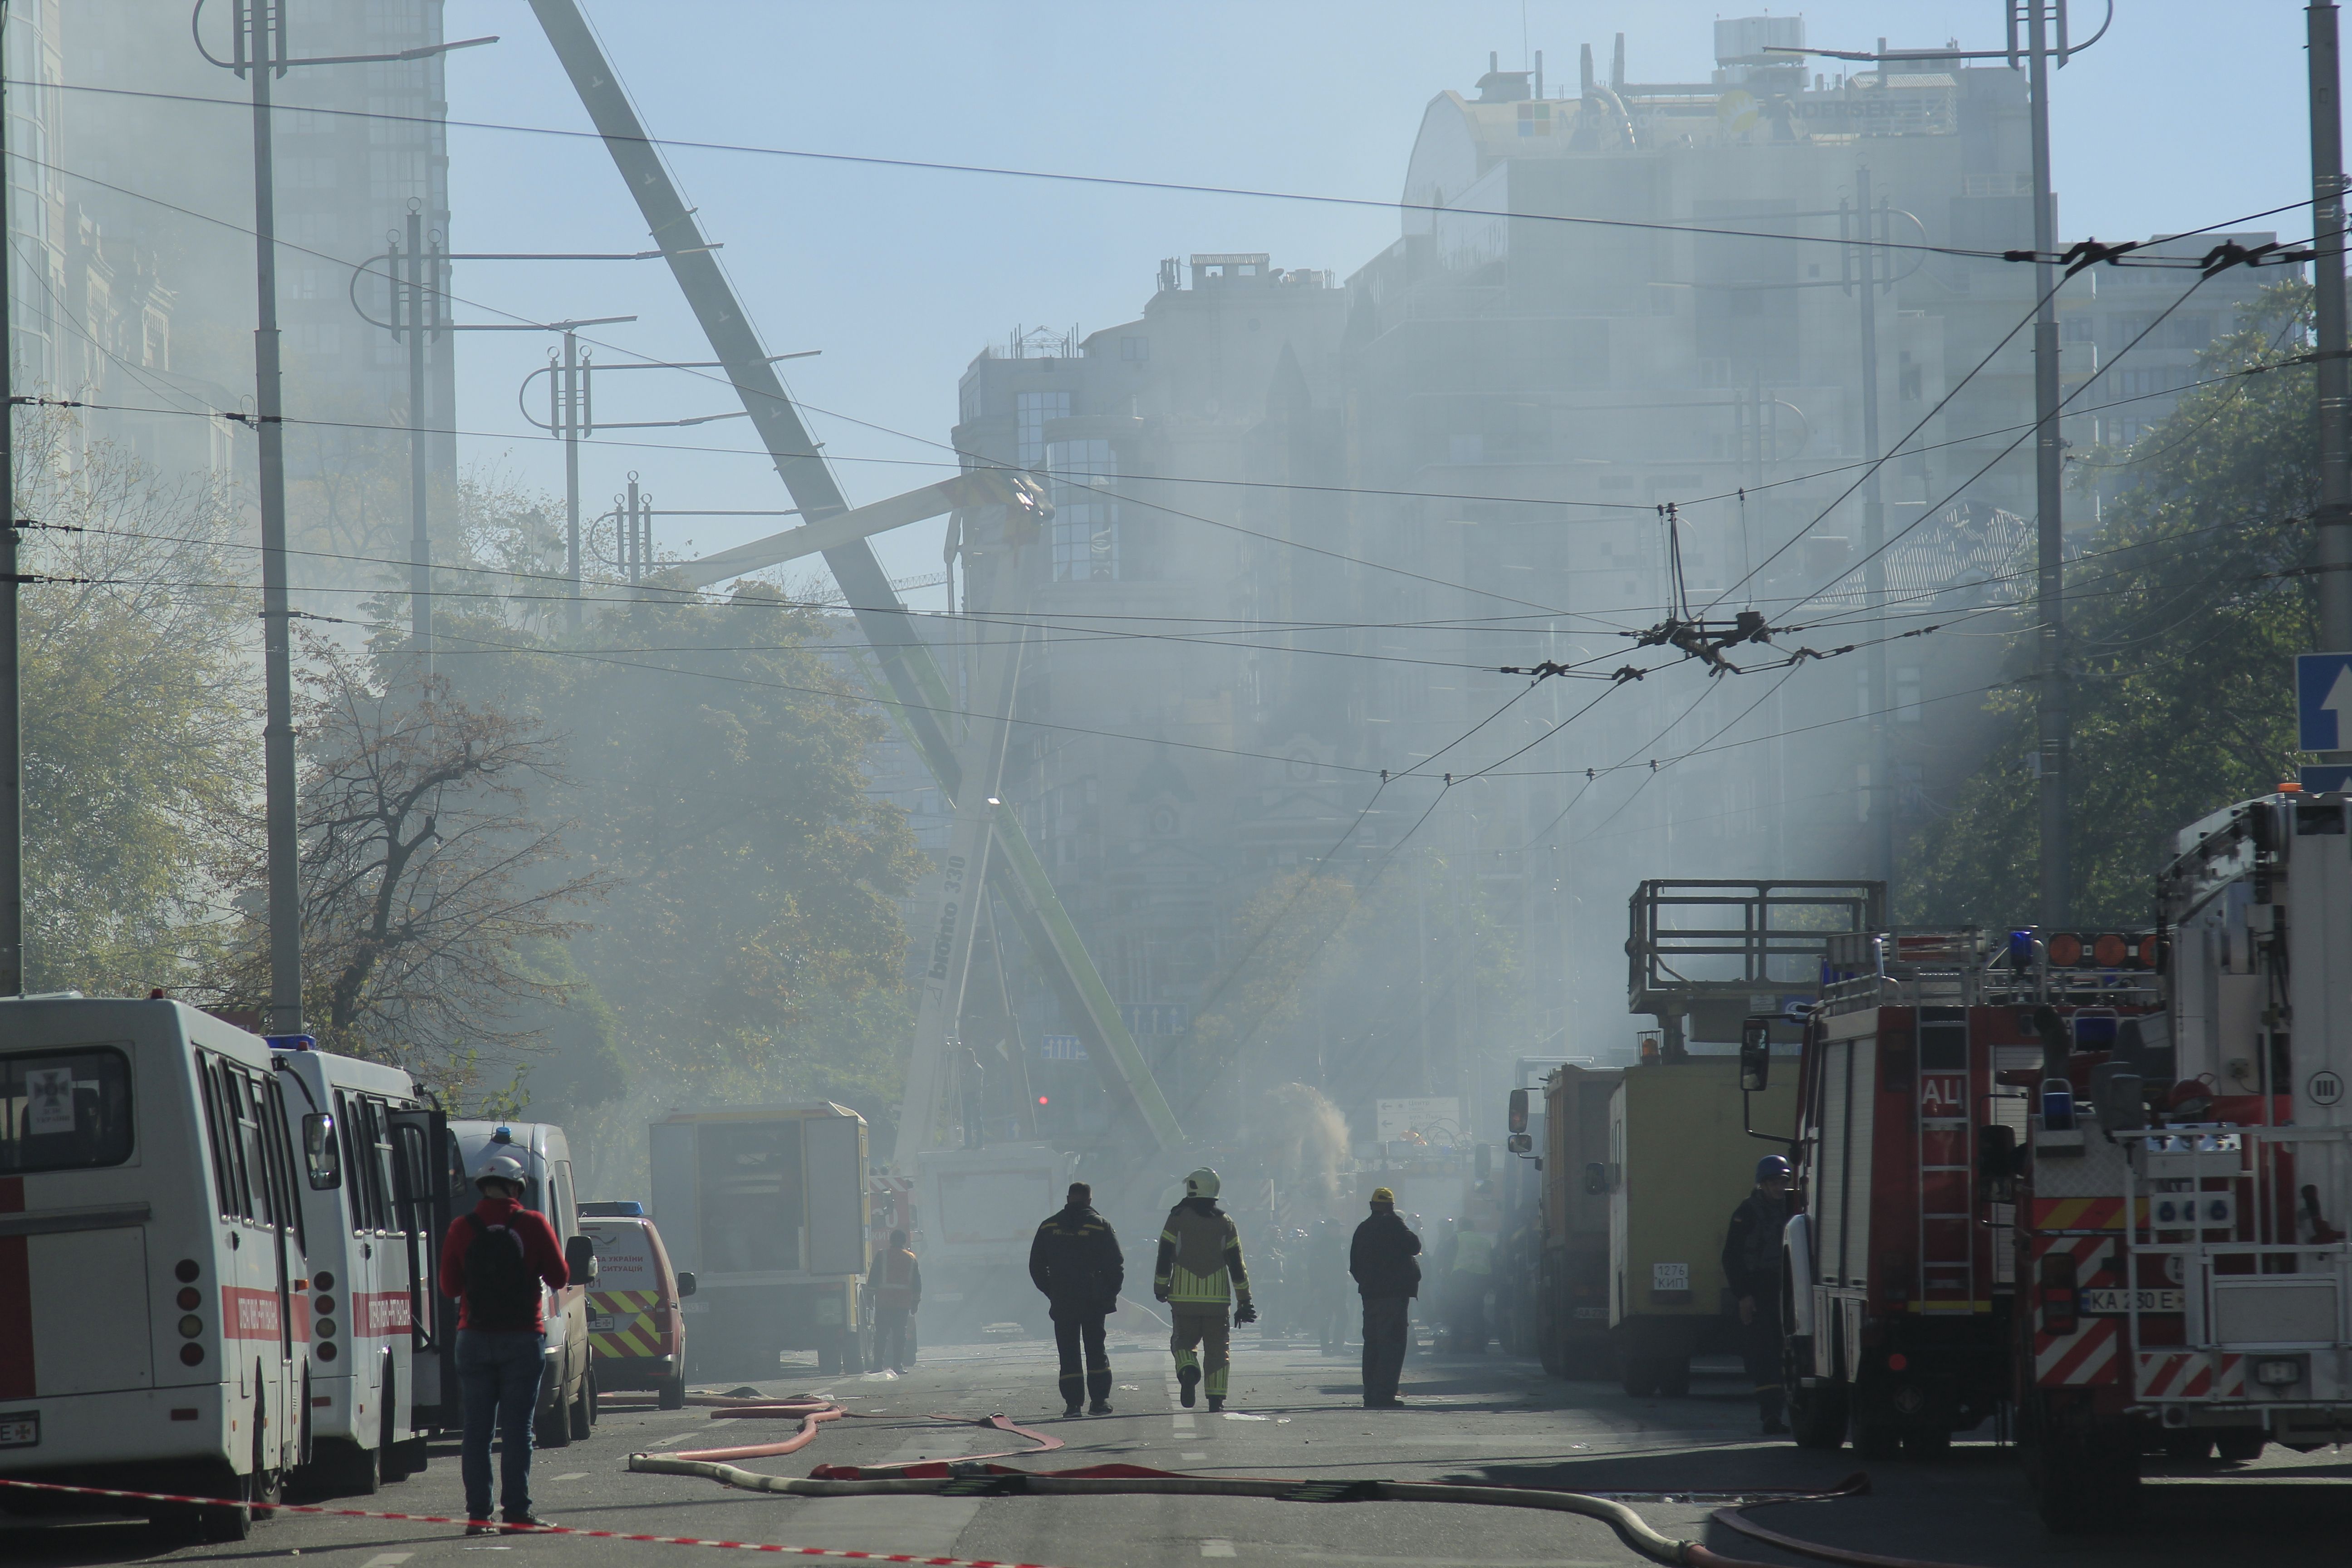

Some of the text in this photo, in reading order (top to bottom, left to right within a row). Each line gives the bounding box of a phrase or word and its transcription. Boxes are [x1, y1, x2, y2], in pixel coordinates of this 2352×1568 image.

[1559, 107, 1667, 129] Micosoft
[1766, 100, 1895, 119] NDERSEN
[928, 855, 965, 980] bronto 330
[1922, 1079, 1963, 1109] АЦ
[872, 1229, 892, 1241] КИЇ
[1658, 1265, 1685, 1275] 1276
[1658, 1278, 1683, 1288] КИП
[2092, 1292, 2117, 1309] KA
[2161, 1292, 2173, 1309] E
[0, 1425, 11, 1441] E
